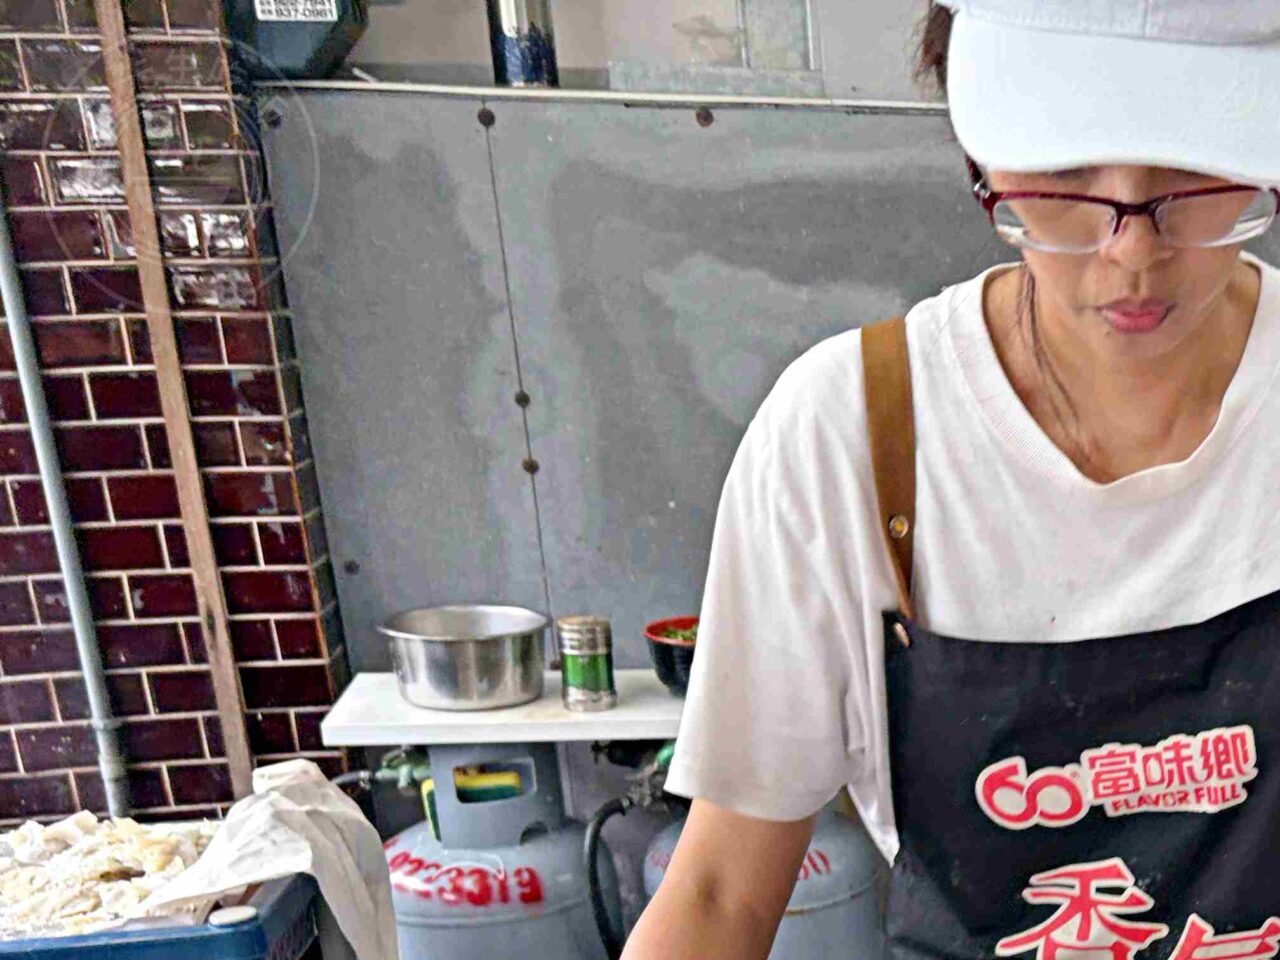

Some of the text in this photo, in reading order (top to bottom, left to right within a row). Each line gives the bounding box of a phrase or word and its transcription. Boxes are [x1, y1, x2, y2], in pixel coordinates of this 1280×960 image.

[1087, 732, 1255, 798] 富味鄉
[1111, 785, 1241, 812] FLAVOR FULL
